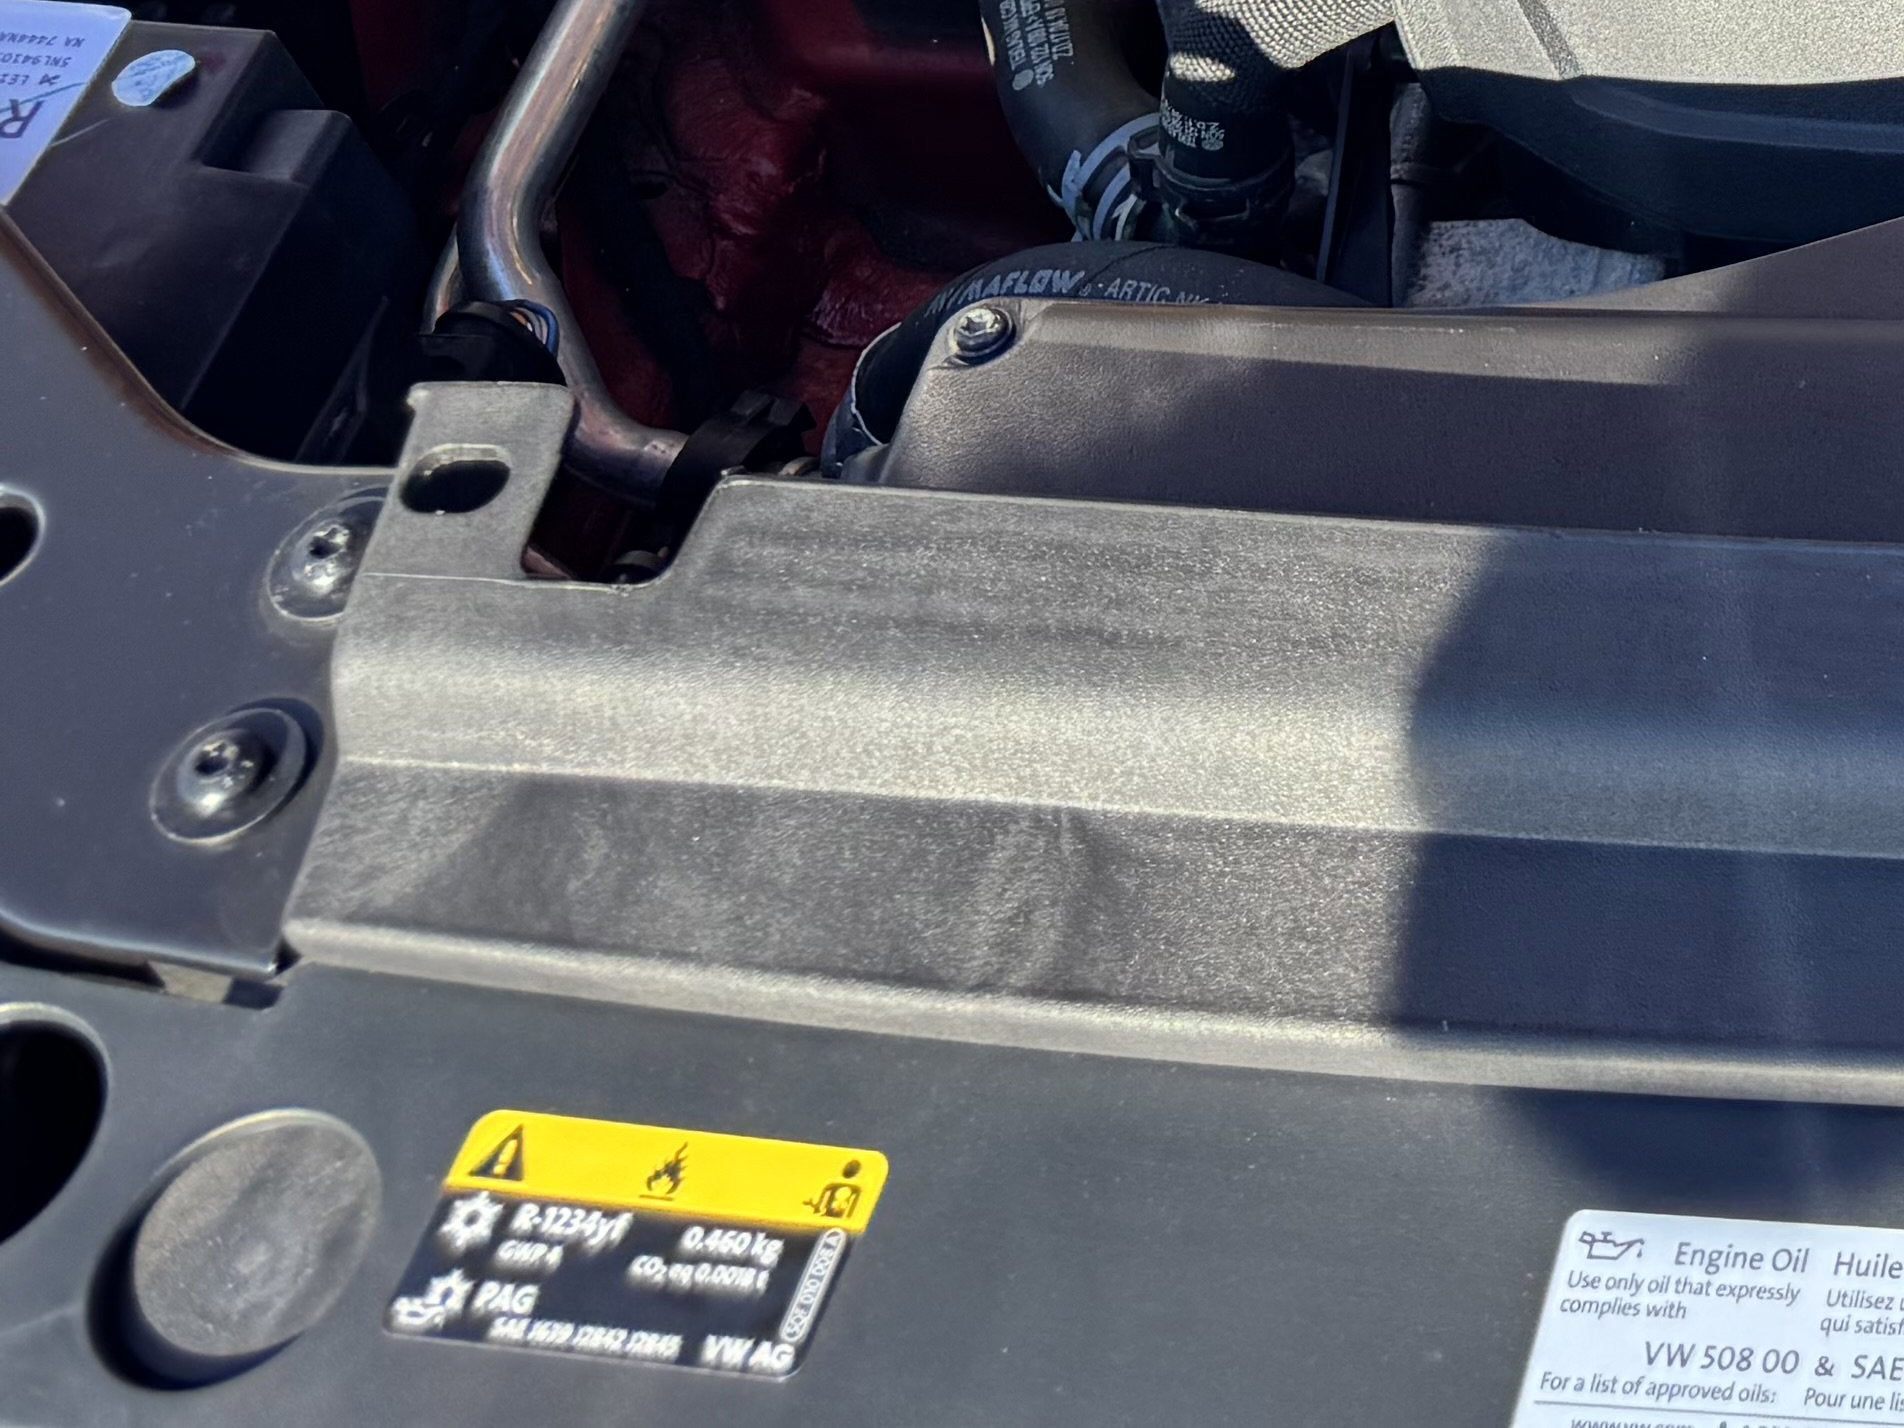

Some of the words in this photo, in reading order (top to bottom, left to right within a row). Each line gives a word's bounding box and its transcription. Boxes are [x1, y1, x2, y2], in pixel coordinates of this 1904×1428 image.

[514, 1202, 633, 1246] R-1234yf
[1674, 1243, 1766, 1276] Engine
[1771, 1247, 1810, 1274] Oil
[1833, 1252, 1904, 1280] Huile
[477, 1280, 541, 1316] PAG
[1566, 1270, 1600, 1289] Use
[1604, 1272, 1645, 1297] only
[1648, 1274, 1671, 1293] oil
[1674, 1276, 1713, 1297] that
[1716, 1281, 1802, 1308] expressly
[1826, 1289, 1895, 1312] Utilisez
[1560, 1295, 1642, 1323] complies
[1646, 1300, 1688, 1320] with
[1820, 1315, 1851, 1337] qui
[703, 1333, 750, 1363] VW
[749, 1340, 797, 1371] AG
[1643, 1341, 1695, 1368] VW
[1702, 1346, 1753, 1373] 508
[1760, 1350, 1800, 1376] 00
[1814, 1355, 1836, 1378] &
[1850, 1355, 1904, 1381] SAE
[1540, 1371, 1570, 1391] For
[1574, 1377, 1587, 1393] a
[1590, 1374, 1619, 1395] list
[1621, 1375, 1643, 1398] of
[1644, 1379, 1734, 1408] approved
[1738, 1383, 1777, 1405] oils:
[1803, 1387, 1842, 1409] Pour
[1846, 1393, 1885, 1410] une
